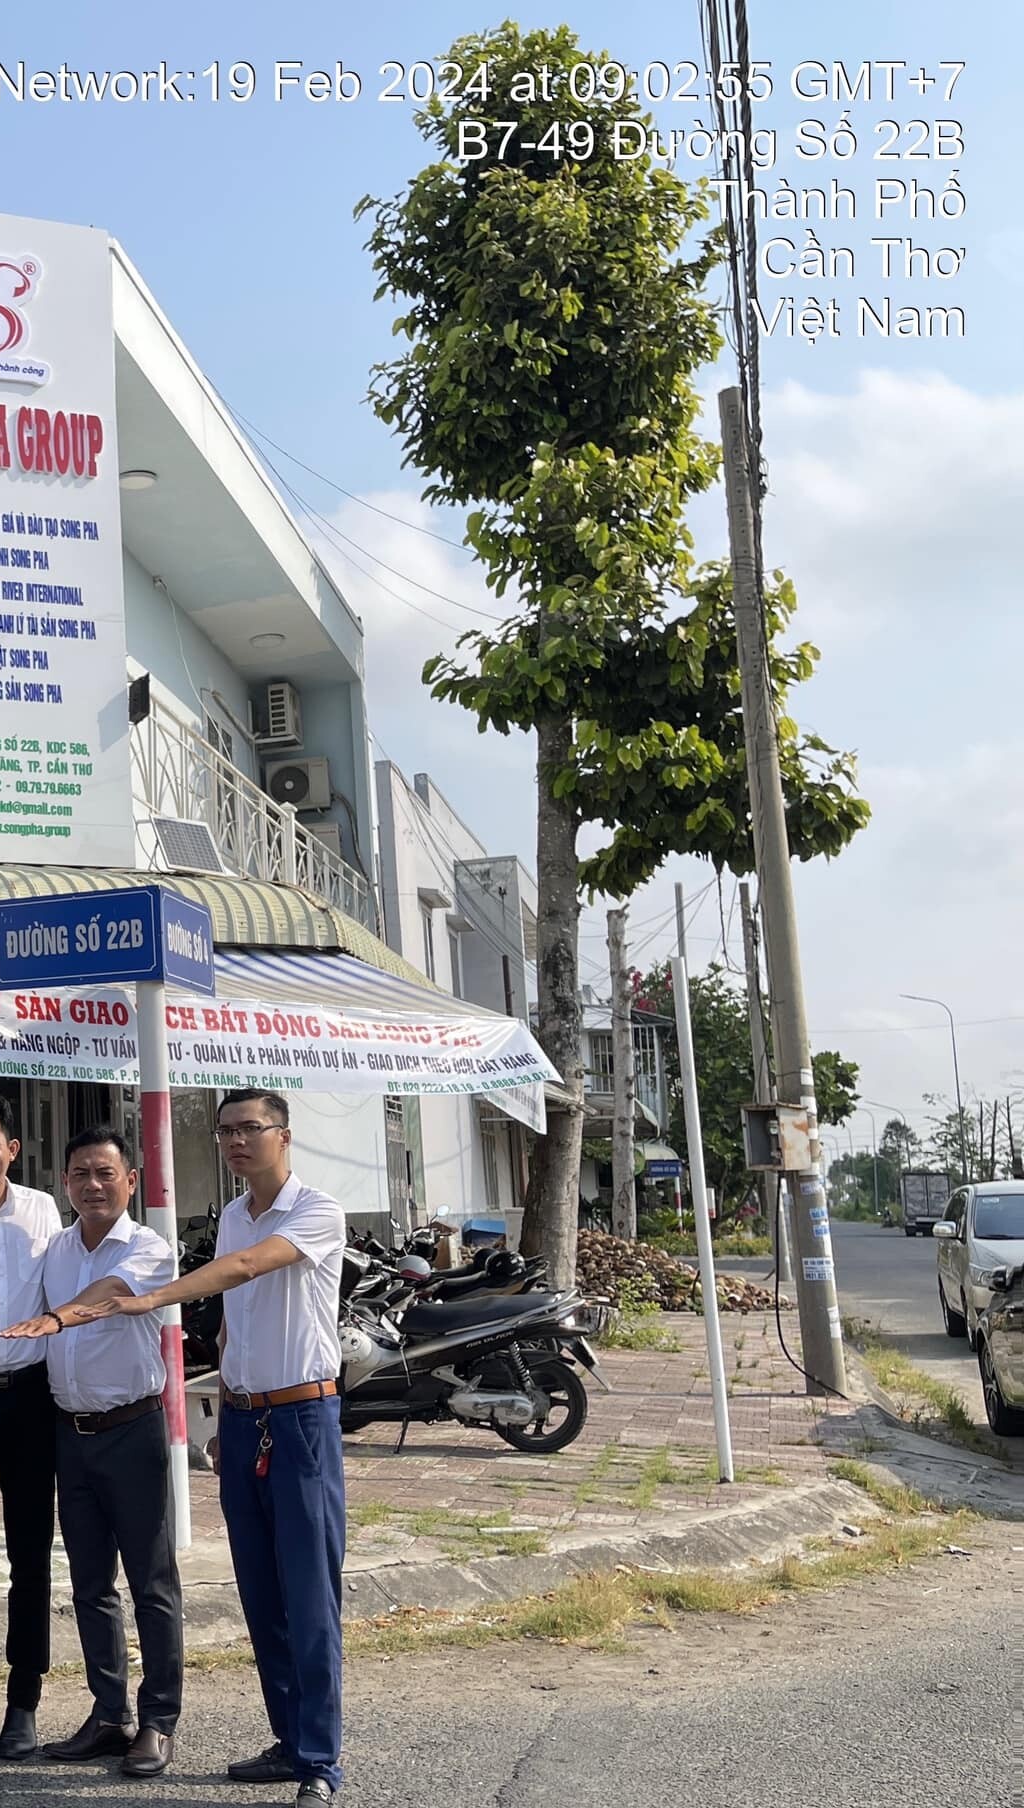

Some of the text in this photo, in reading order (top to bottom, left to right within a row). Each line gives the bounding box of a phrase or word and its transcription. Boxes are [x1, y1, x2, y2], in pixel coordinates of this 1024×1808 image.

[22, 366, 44, 376] công
[17, 406, 103, 478] GROUP
[2, 581, 24, 601] RIVER
[26, 583, 83, 606] INTERNATIONAL
[10, 649, 30, 668] SONG
[33, 650, 48, 670] PHA
[5, 675, 21, 701] SẢN
[24, 683, 44, 702] SONG
[47, 684, 62, 703] PHA
[4, 734, 17, 751] SỐ
[21, 740, 42, 754] 22B,
[47, 741, 66, 754] KDC
[70, 743, 90, 757] 586,
[16, 781, 81, 795] 09.79.79.6663
[6, 913, 144, 959] ĐƯỜNG SỐ 22B
[167, 920, 208, 965] ĐƯỜNG SỐ 4
[15, 991, 321, 1041] SÀN GIAO BẤT ĐỘNG
[48, 1032, 80, 1059] NGỘP
[92, 1037, 110, 1057] TƯ
[112, 1031, 136, 1058] VẤN
[167, 1042, 182, 1061] TƯ
[194, 1038, 227, 1064] QUẢN
[229, 1042, 242, 1063] LÝ
[247, 1046, 255, 1064] &
[258, 1045, 292, 1066] PHÂN
[295, 1044, 321, 1068] PHỐI
[323, 1048, 339, 1072] DỰ
[342, 1048, 363, 1069] ÁN
[368, 1053, 394, 1071] GIAO
